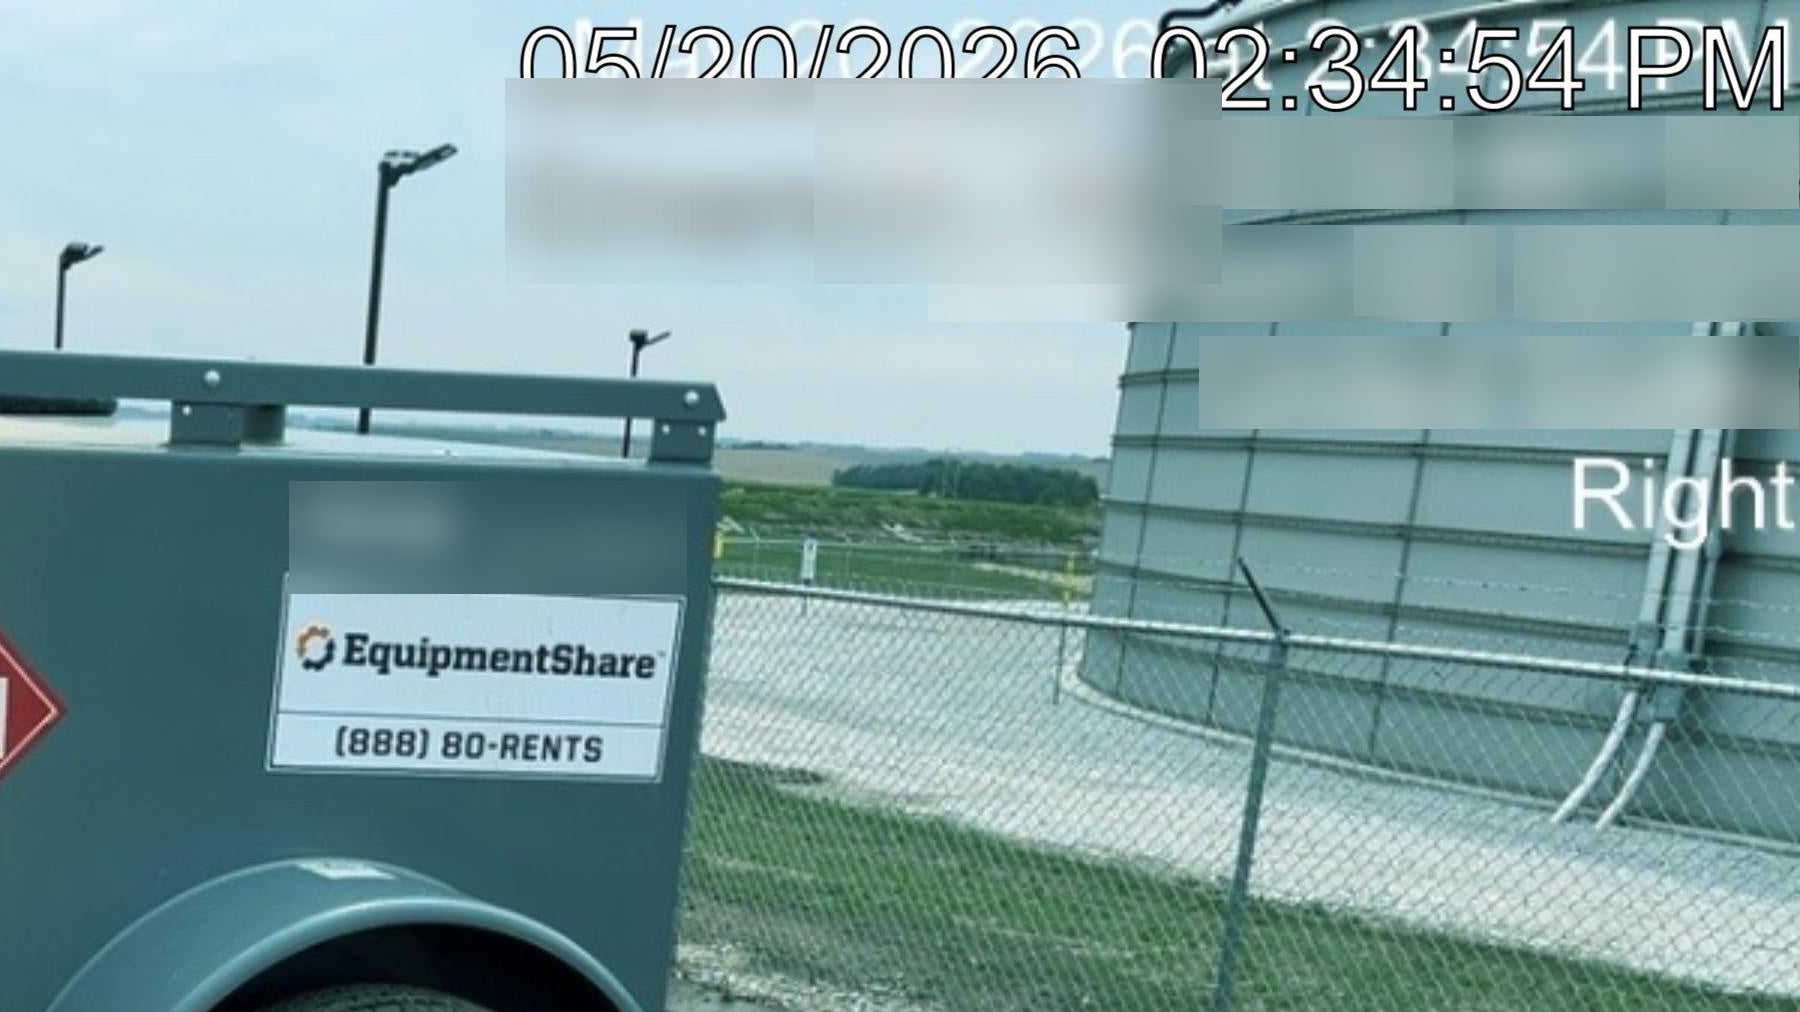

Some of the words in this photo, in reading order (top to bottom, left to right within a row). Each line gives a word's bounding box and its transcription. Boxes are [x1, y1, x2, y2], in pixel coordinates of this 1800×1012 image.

[342, 631, 656, 680] EquipmentShare
[335, 725, 430, 760] (888)
[441, 732, 604, 764] 80-RENTS
